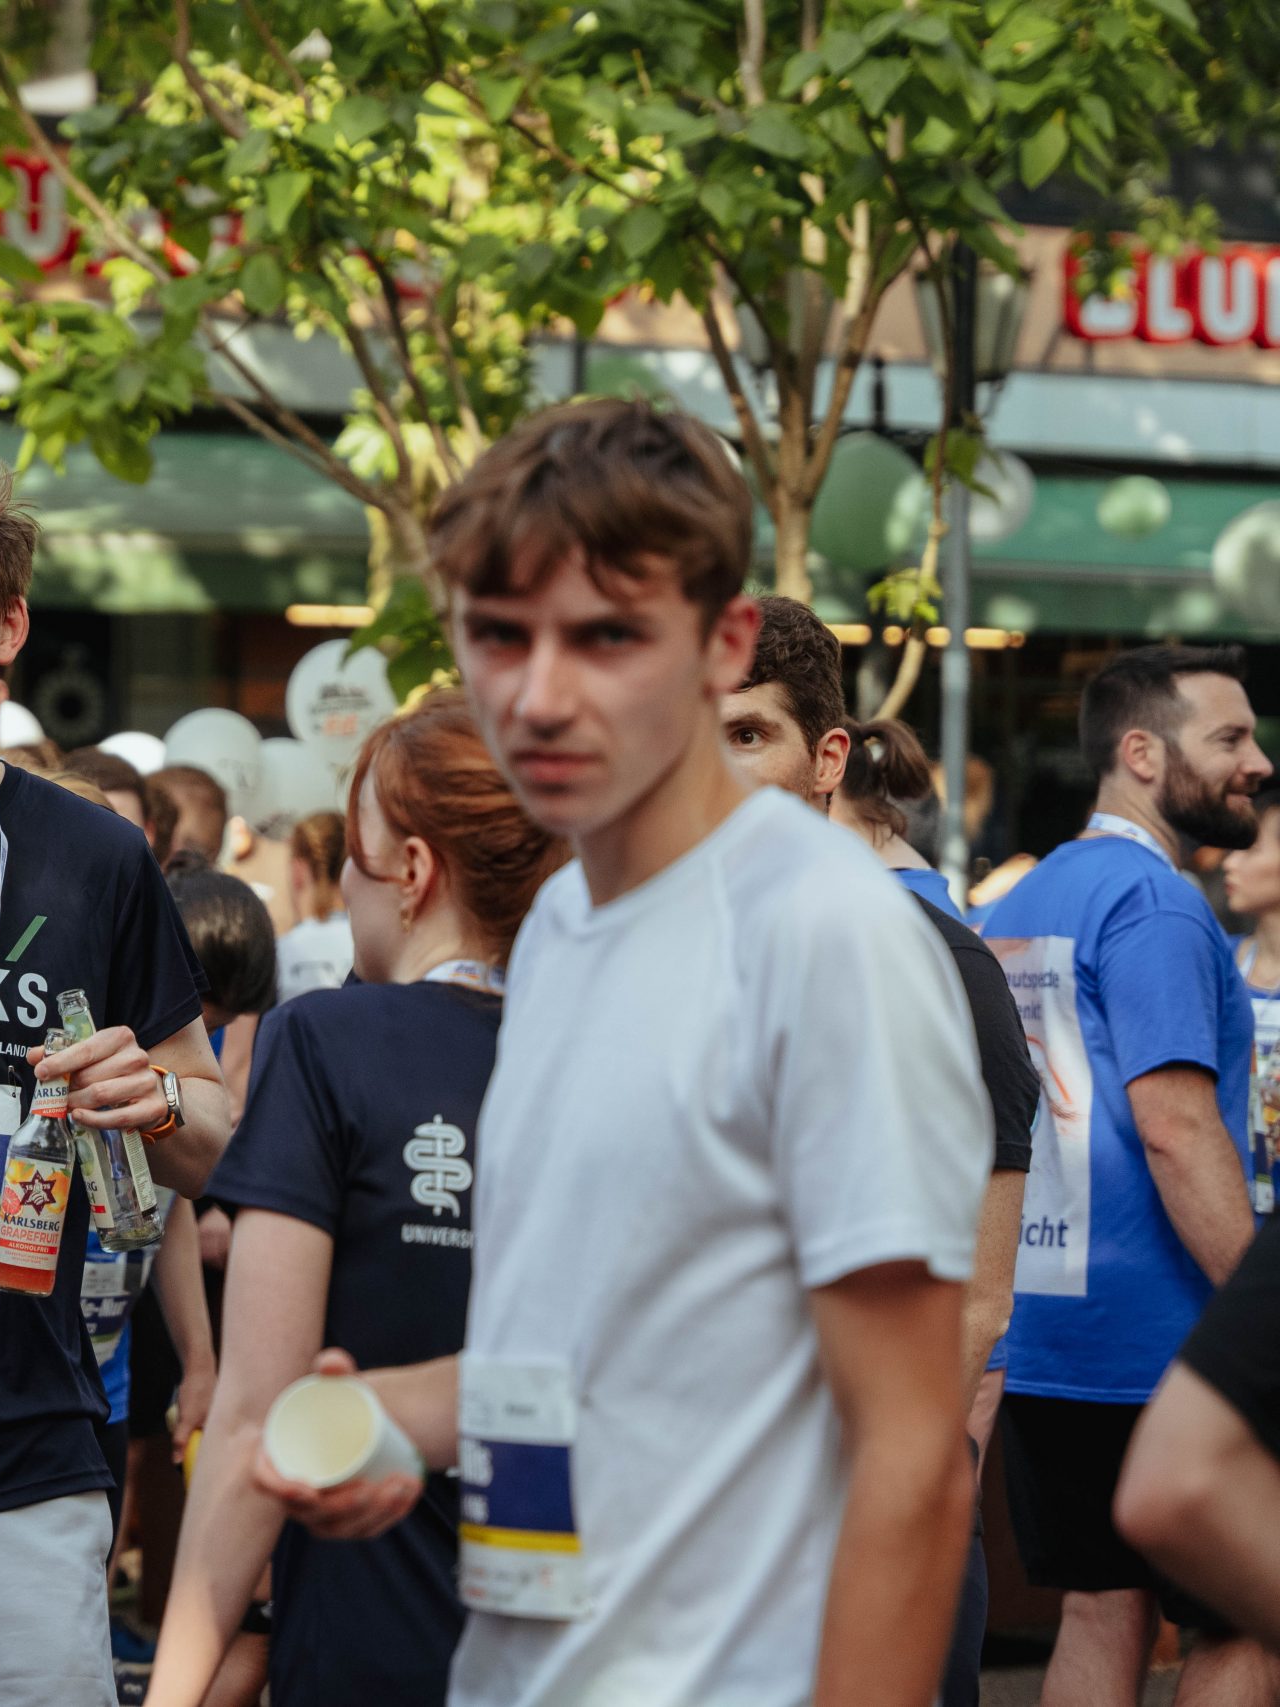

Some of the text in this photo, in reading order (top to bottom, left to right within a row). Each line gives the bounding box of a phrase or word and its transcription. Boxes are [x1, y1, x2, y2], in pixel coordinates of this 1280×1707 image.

[3, 1212, 60, 1232] KARLSBERG
[1018, 1214, 1070, 1248] icht
[0, 1225, 59, 1245] GRAPEFRUIT
[401, 1223, 474, 1249] UNIVERSI
[8, 1241, 49, 1254] ALKOHOLFREI
